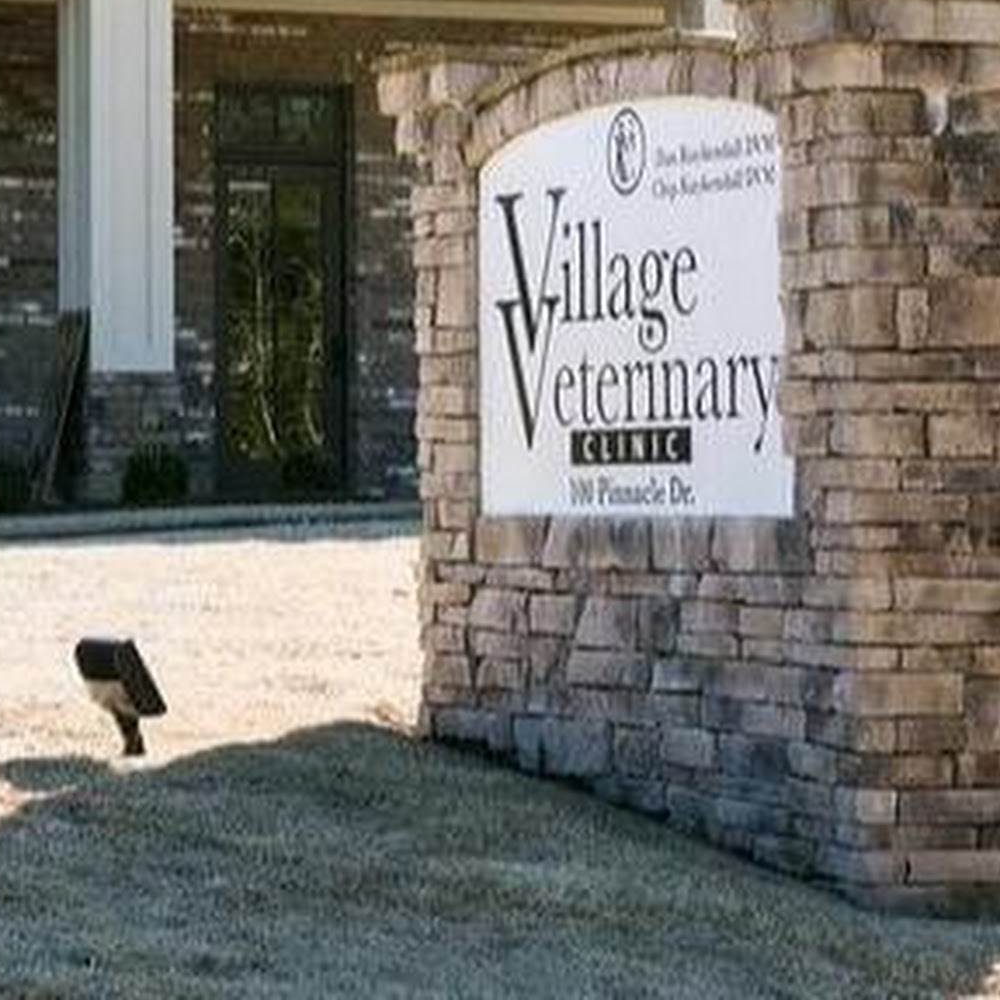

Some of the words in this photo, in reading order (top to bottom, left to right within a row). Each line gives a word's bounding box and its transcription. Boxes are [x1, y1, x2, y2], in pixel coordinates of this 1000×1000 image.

[495, 188, 698, 354] Village
[495, 296, 778, 453] Veterinary
[582, 430, 678, 461] CLINIC
